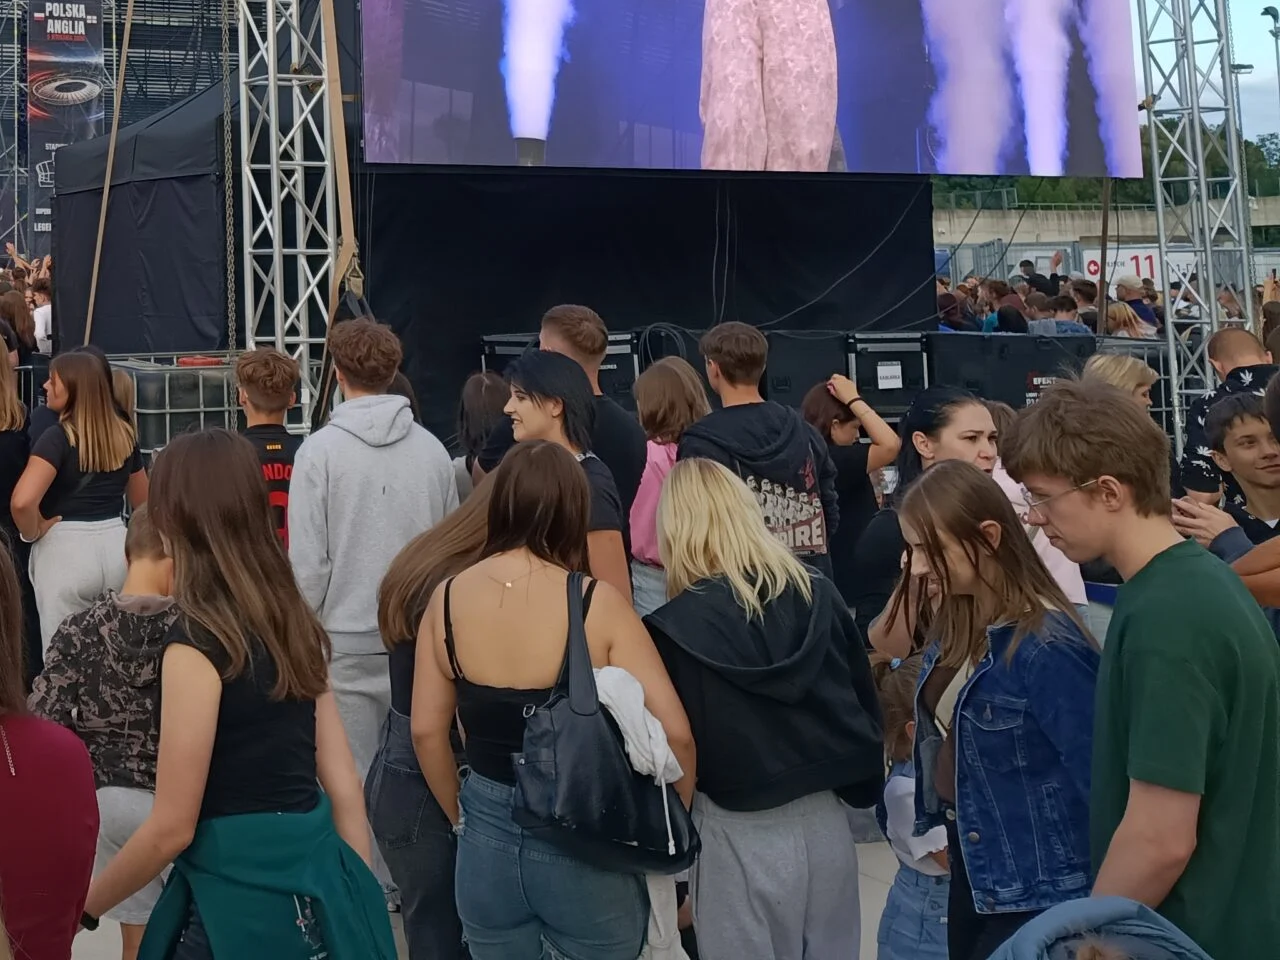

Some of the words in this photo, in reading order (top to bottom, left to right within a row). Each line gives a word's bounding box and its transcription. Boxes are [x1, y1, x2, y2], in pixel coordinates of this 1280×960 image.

[45, 2, 86, 18] POLSKA
[47, 19, 85, 35] ANGLIA
[1130, 254, 1155, 280] 11
[774, 517, 823, 548] PIRE
